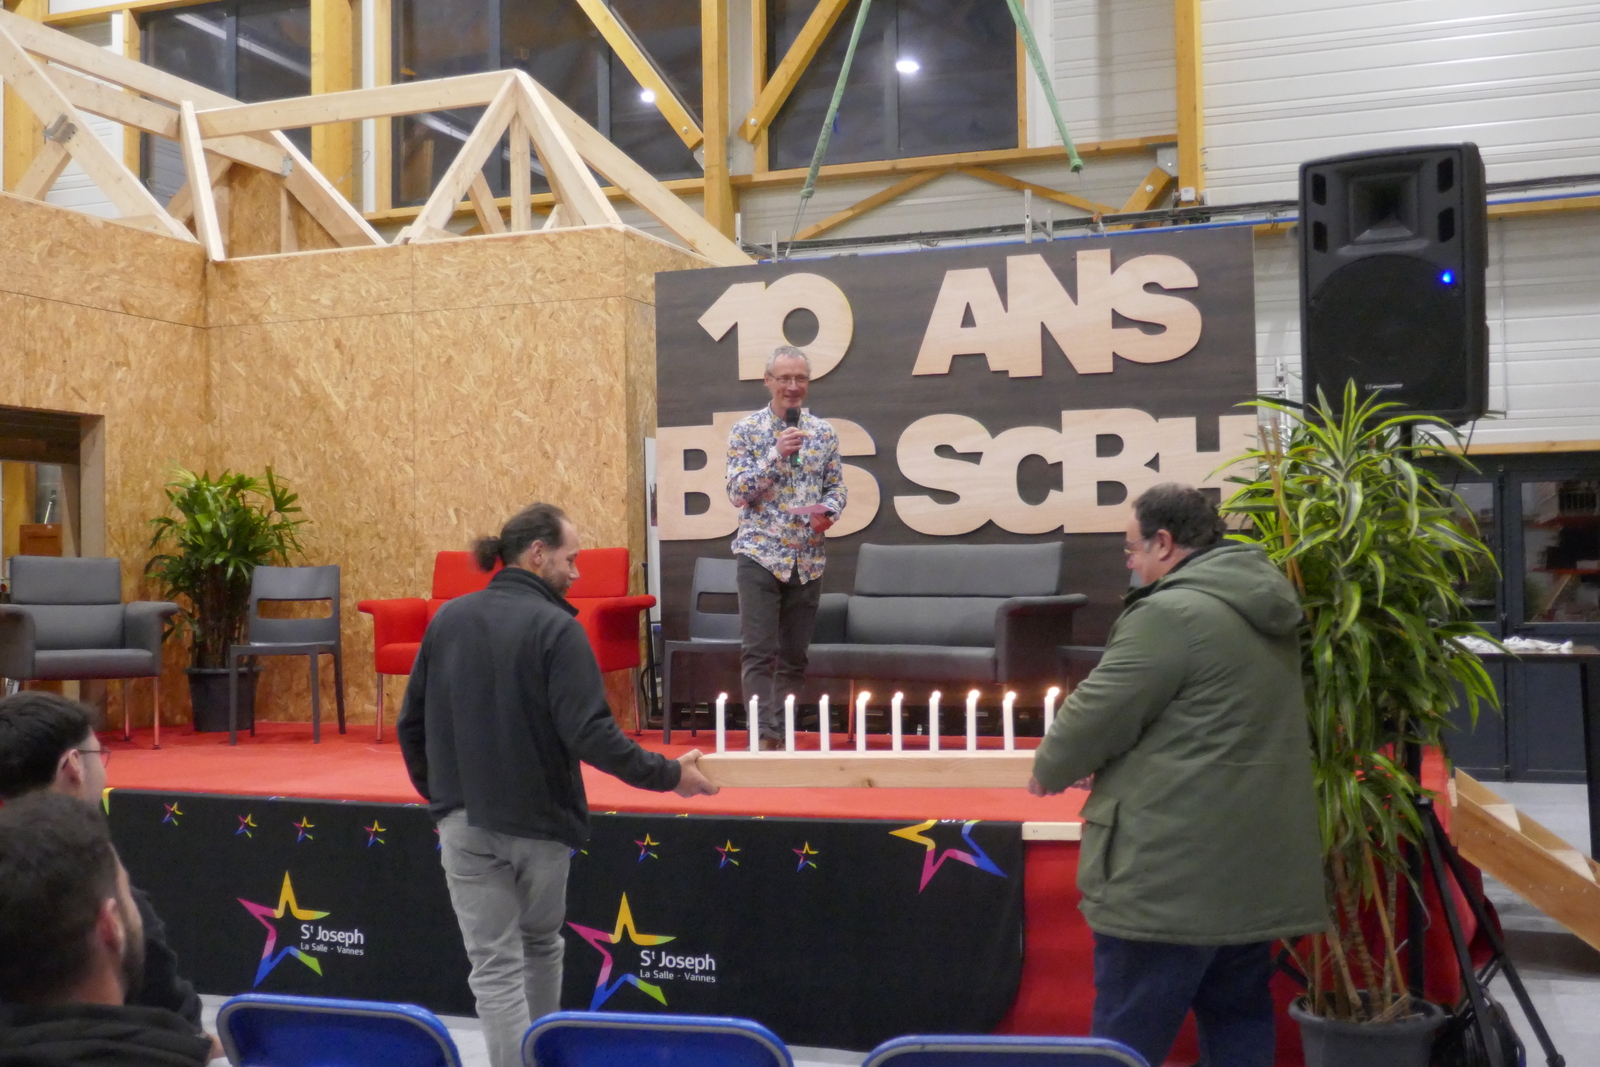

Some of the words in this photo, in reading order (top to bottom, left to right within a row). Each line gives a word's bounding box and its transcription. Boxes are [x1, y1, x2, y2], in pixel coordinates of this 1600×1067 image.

[697, 272, 854, 382] 10
[911, 248, 1203, 378] ANS
[656, 407, 881, 541] BS
[893, 407, 1258, 537] SCBH
[316, 925, 365, 947] Joseph
[300, 942, 310, 951] La
[311, 942, 328, 953] Salle
[336, 945, 365, 956] Vannes
[658, 951, 716, 974] Joseph
[640, 969, 651, 978] La
[653, 970, 674, 980] Salle
[684, 972, 716, 983] Vannes
